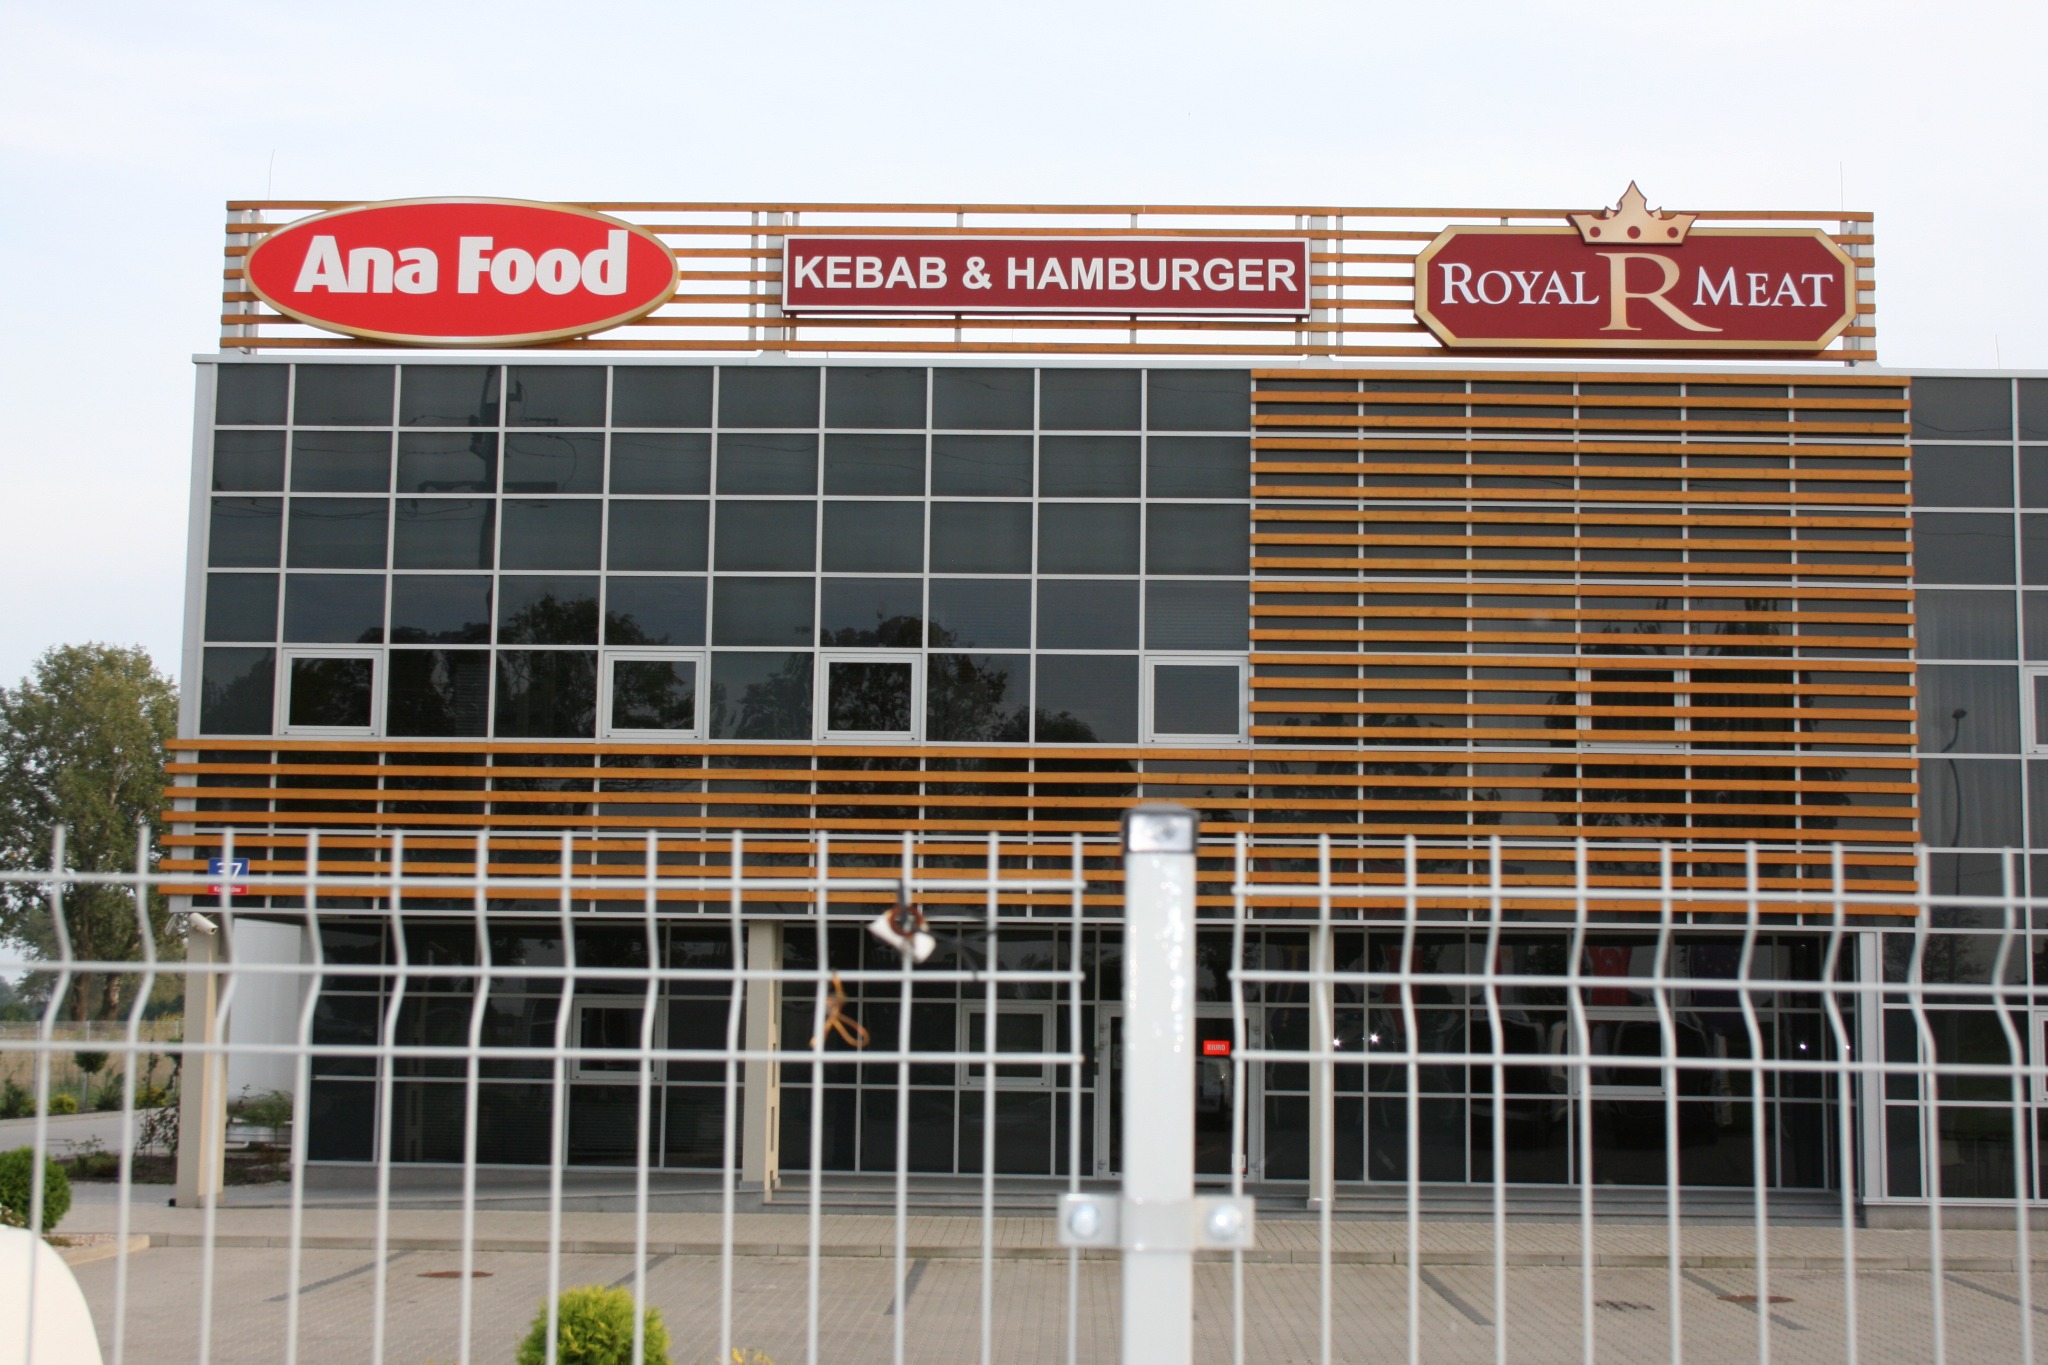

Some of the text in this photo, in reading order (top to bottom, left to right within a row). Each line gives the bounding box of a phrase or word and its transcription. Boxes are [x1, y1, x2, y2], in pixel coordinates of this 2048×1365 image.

[294, 229, 629, 296] Ana Food
[794, 255, 1299, 292] KEBAB & HAMBURGER
[1438, 252, 1834, 332] ROYAL R MEAT
